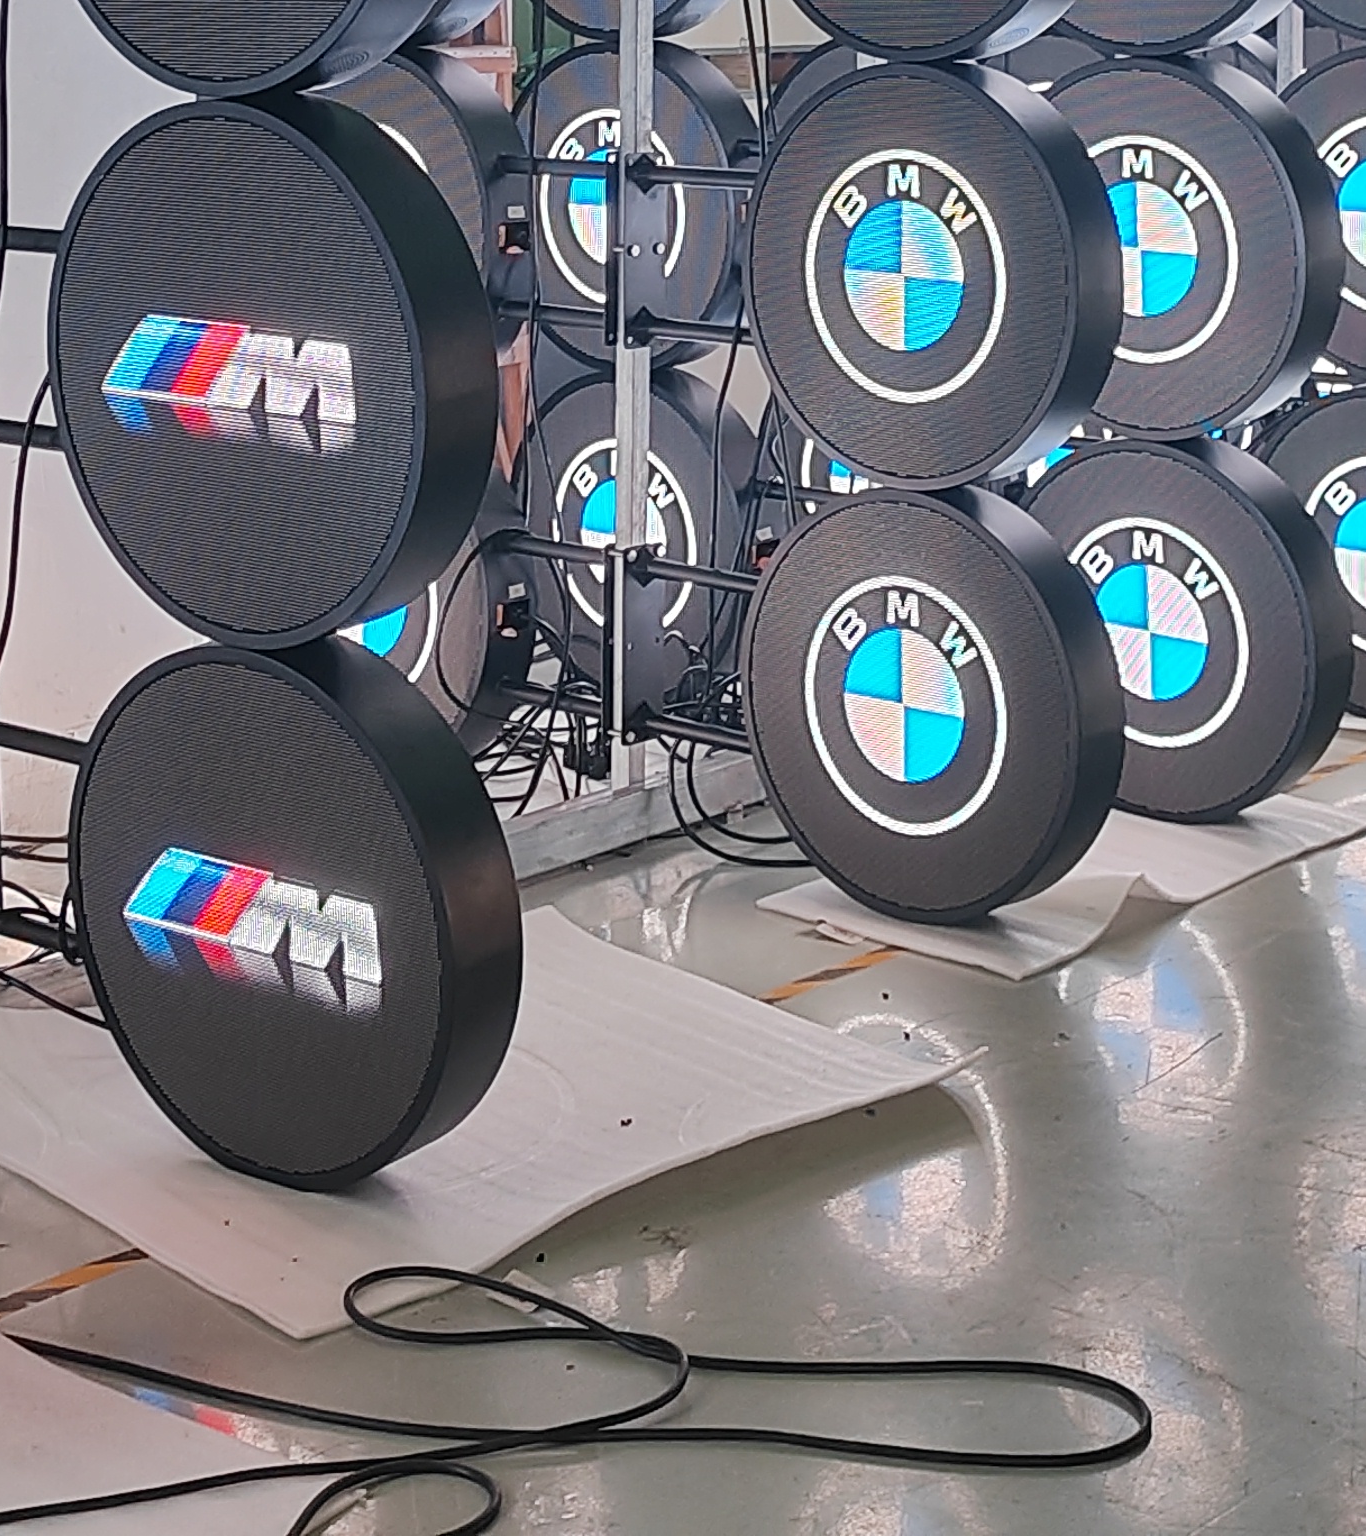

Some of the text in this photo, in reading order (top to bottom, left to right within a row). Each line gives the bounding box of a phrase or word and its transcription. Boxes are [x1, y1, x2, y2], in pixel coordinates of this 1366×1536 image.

[833, 164, 977, 233] BMW
[1121, 148, 1209, 211] MW
[573, 449, 675, 508] BW
[1081, 531, 1219, 601] BMW
[833, 590, 977, 669] BMW
